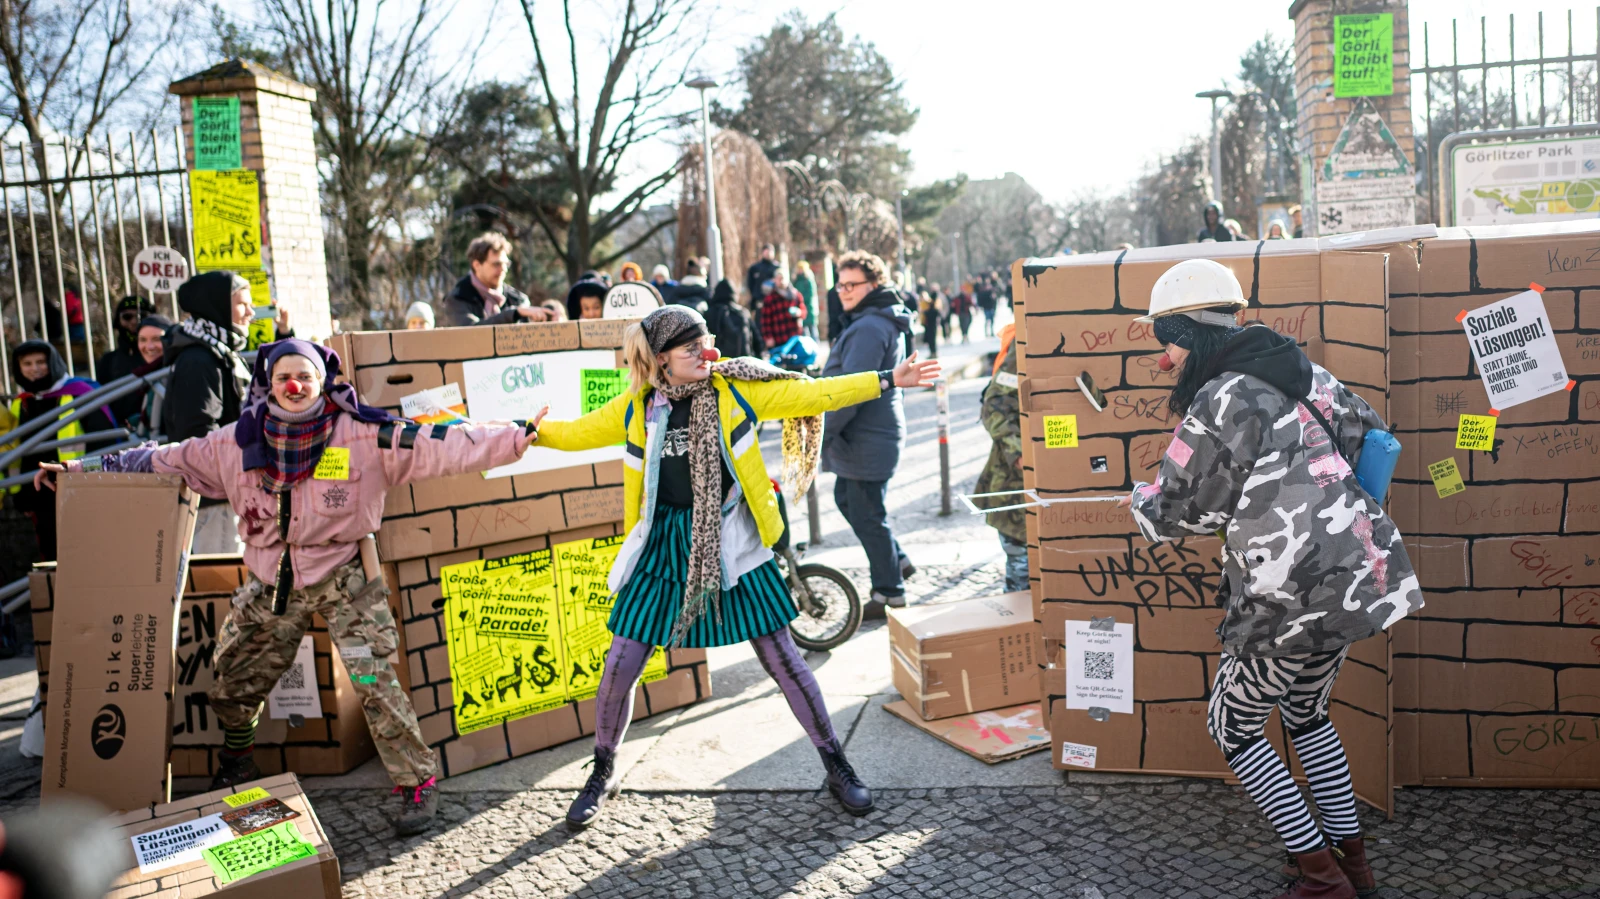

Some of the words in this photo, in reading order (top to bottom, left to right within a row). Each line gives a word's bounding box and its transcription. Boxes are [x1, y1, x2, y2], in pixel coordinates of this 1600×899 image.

[1342, 28, 1369, 39] Der
[1342, 53, 1388, 66] bleibt
[1342, 66, 1374, 79] auf!
[200, 108, 221, 119] Der
[200, 133, 236, 142] bleibt
[1465, 148, 1533, 163] Görlitzer
[1538, 145, 1573, 158] Park
[153, 251, 171, 261] ICH
[138, 261, 184, 278] DREH
[155, 278, 170, 290] AB
[610, 290, 639, 308] GÖRLI
[1467, 305, 1518, 337] Soziale
[1080, 327, 1118, 352] Der
[1474, 317, 1547, 358] Lösungen!
[1483, 358, 1505, 374] STATT
[1486, 364, 1522, 384] KAMERAS
[1522, 358, 1539, 373] UND
[501, 361, 546, 393] GRÜN
[588, 380, 611, 391] Der
[1490, 377, 1519, 396] POLIZEI.
[442, 388, 458, 399] alle
[1463, 418, 1480, 426] Der
[1048, 432, 1073, 440] bleibt
[1460, 433, 1489, 441] bleibt
[1462, 426, 1485, 434] Görli
[1460, 440, 1480, 448] auf!
[1547, 434, 1594, 459] OFFEN
[561, 551, 595, 563] Große
[449, 574, 487, 586] Große
[480, 602, 549, 617] mitmach-
[479, 616, 549, 633] Parade!
[105, 614, 124, 693] bikes
[127, 613, 144, 692] Superleichte
[141, 614, 158, 691] Kinderräder
[60, 718, 71, 750] Montage
[1064, 743, 1096, 752] BOYCOTT
[1064, 748, 1096, 758] TESLA
[57, 752, 68, 789] Komplette
[137, 824, 194, 844] Soziale
[139, 822, 221, 852] Lösungen!
